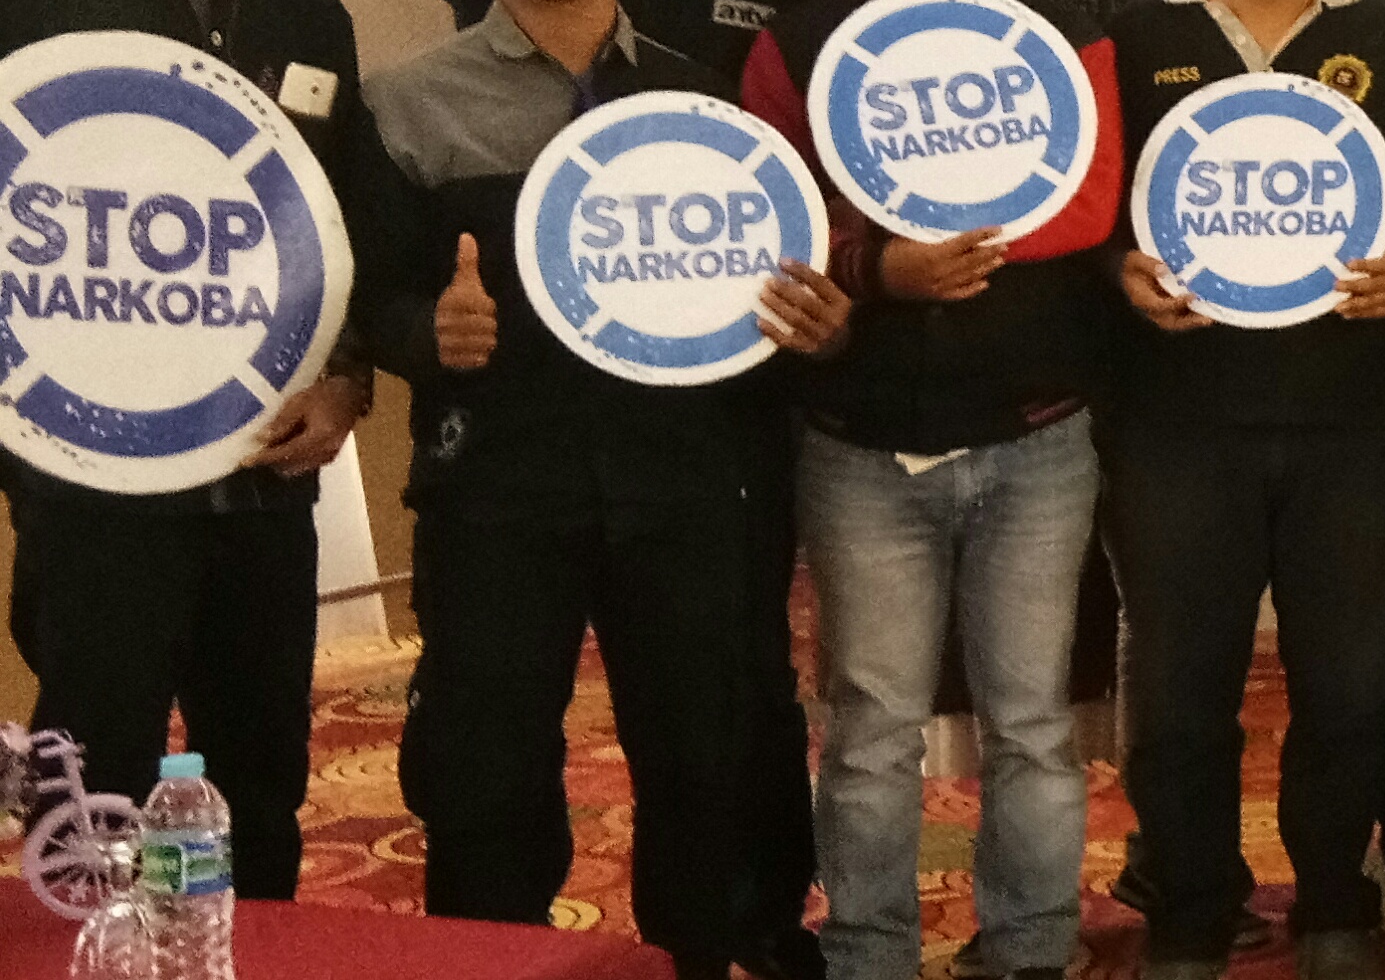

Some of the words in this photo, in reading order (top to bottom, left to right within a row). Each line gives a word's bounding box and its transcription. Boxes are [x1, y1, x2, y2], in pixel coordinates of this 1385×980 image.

[866, 66, 1035, 130] STOP
[1154, 66, 1200, 86] PRESS
[871, 112, 1051, 166] NARKOBA
[1187, 161, 1349, 205] STOP
[6, 181, 265, 276] STOP
[580, 193, 770, 247] STOP
[1179, 210, 1349, 236] NARKOBA
[578, 249, 777, 283] NARKOBA
[0, 272, 273, 327] NARKOBA
